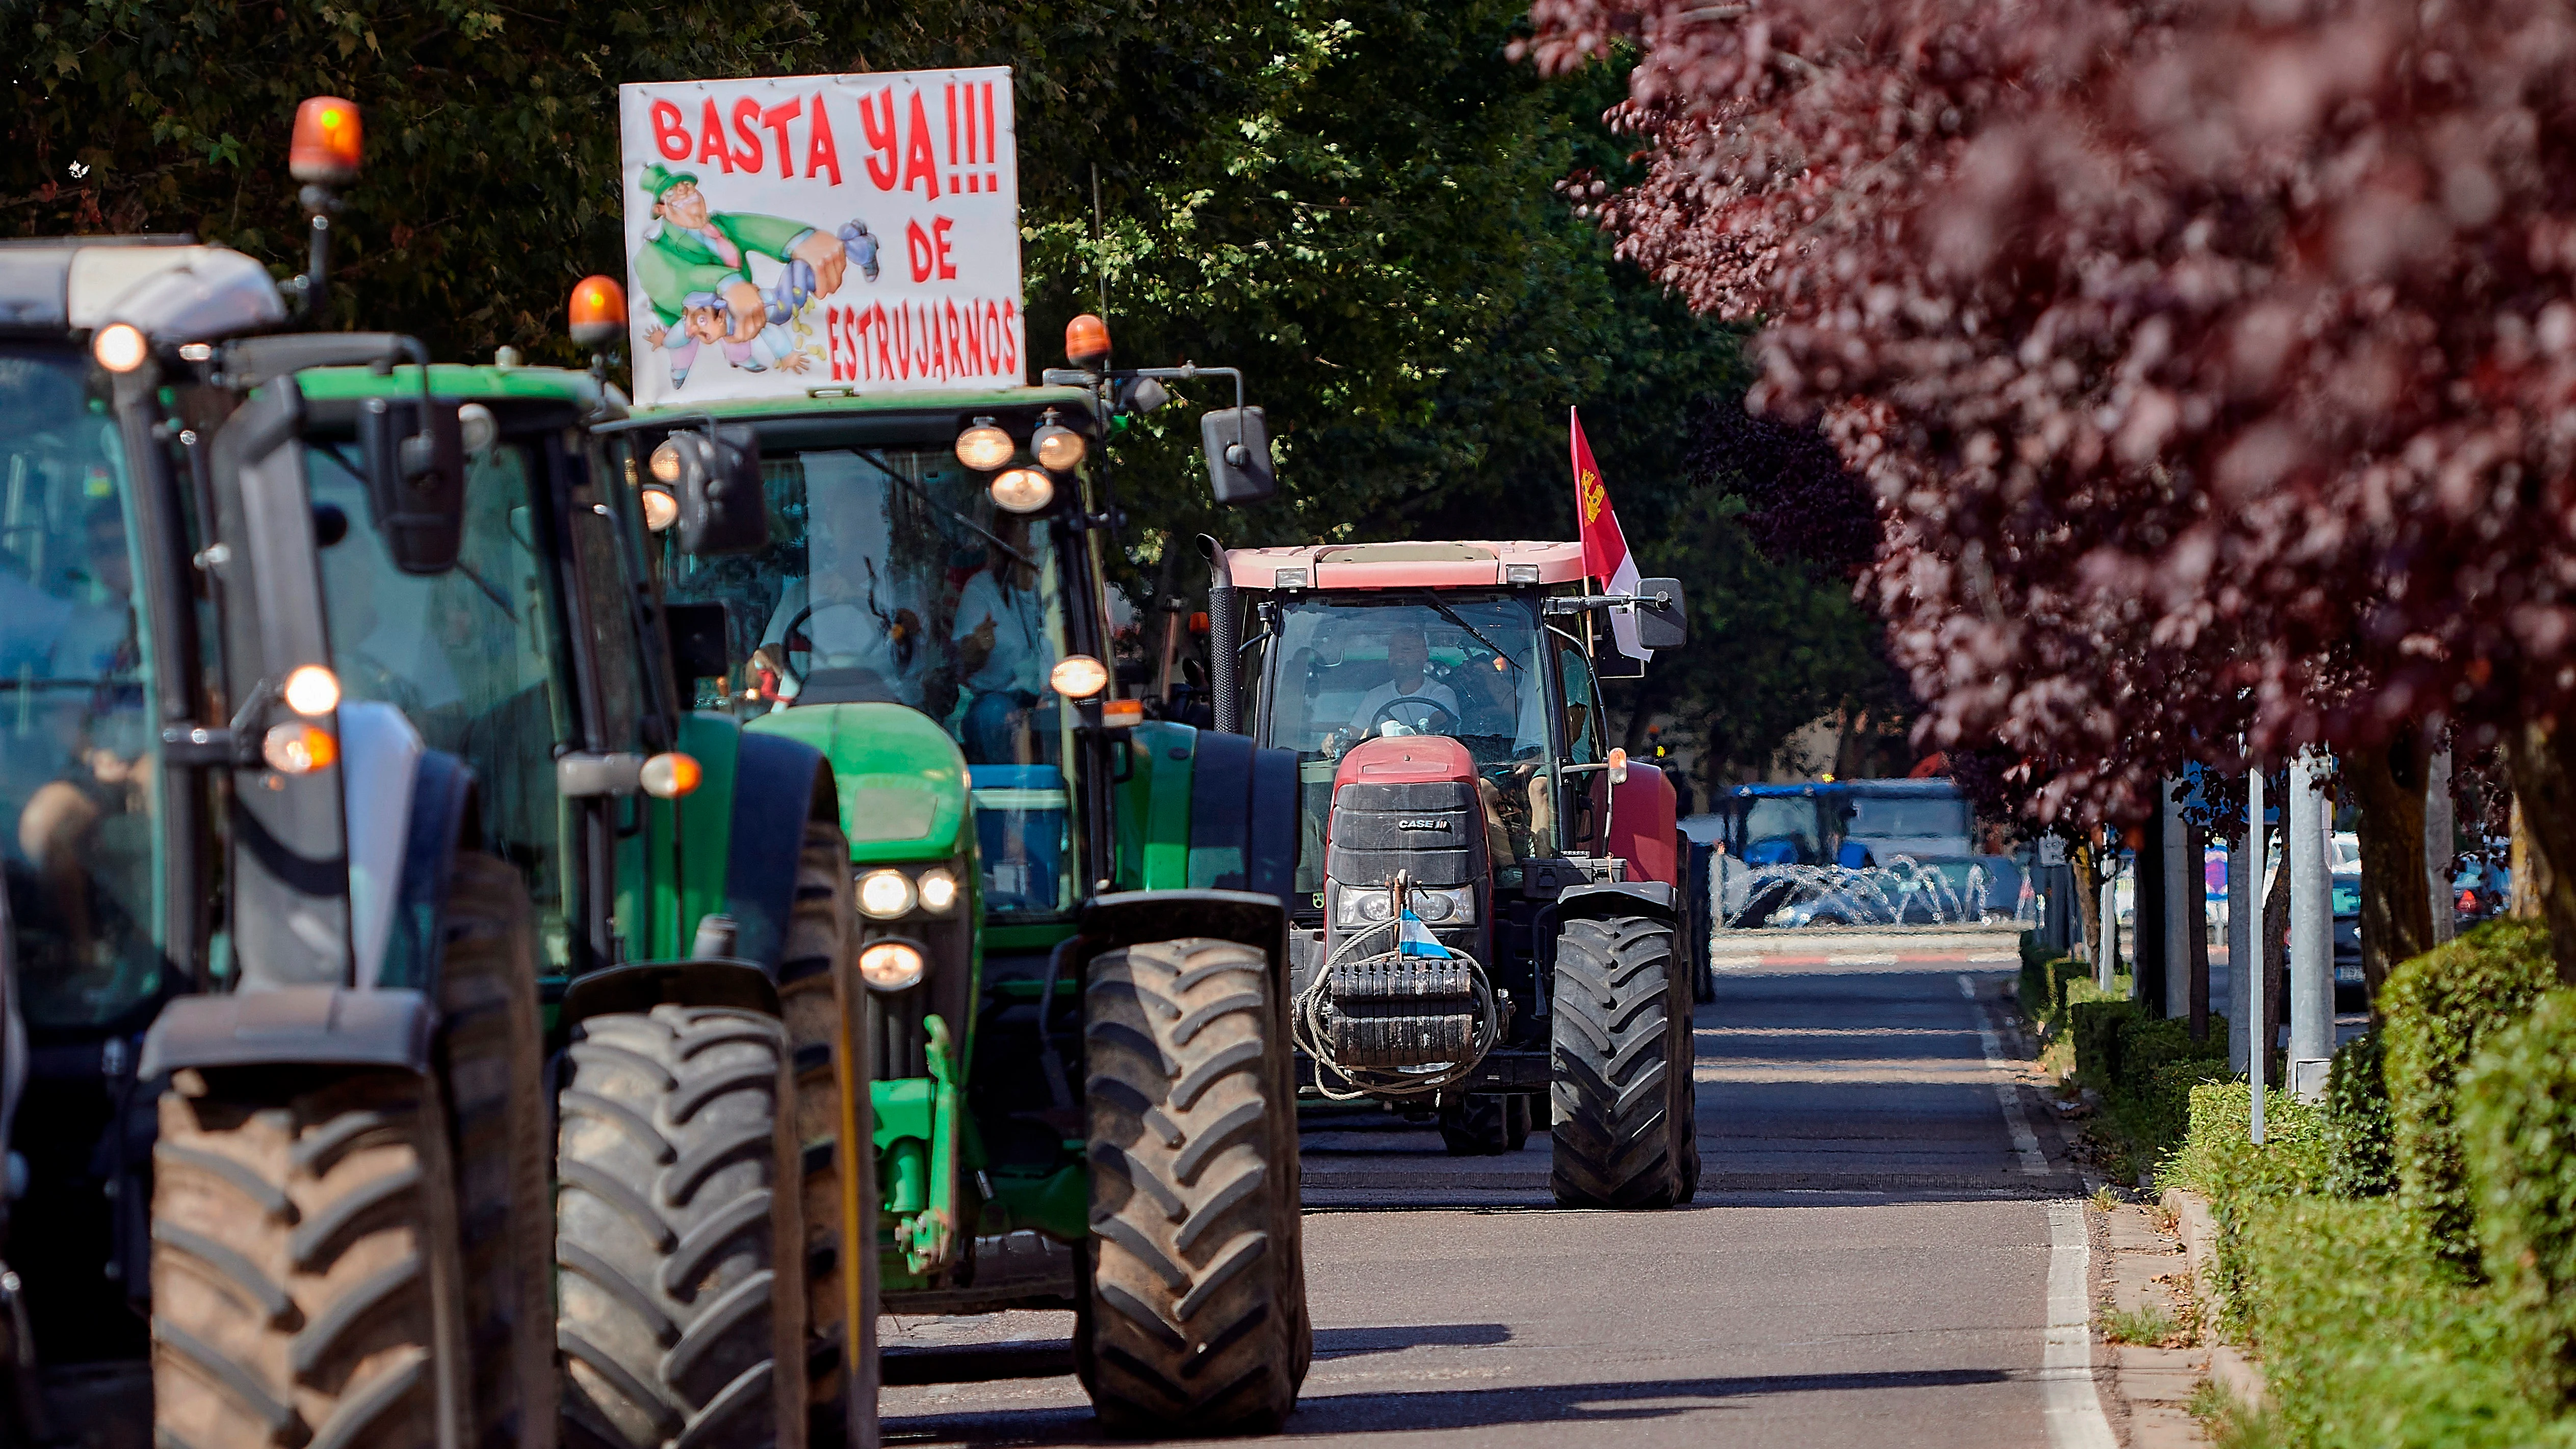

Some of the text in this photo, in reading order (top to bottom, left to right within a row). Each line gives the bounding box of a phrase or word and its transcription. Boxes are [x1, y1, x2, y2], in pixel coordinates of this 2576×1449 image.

[648, 80, 998, 202] BASTA YA!!!
[904, 214, 957, 283] DE
[825, 294, 1017, 383] ESTRUJARNOS
[1398, 820, 1434, 829] CASE
